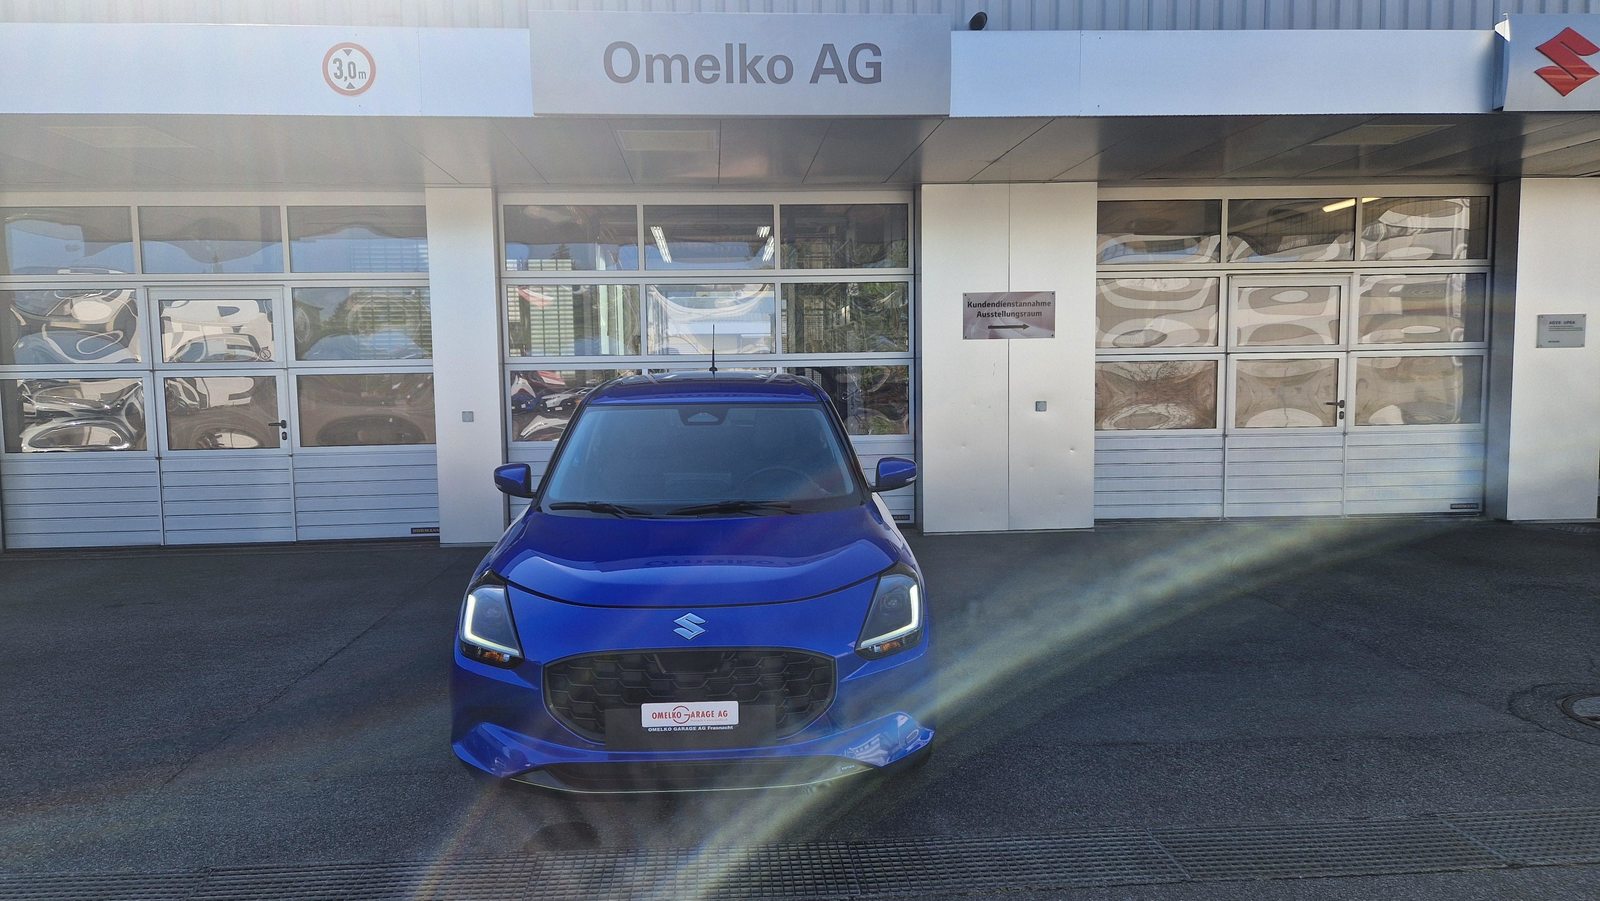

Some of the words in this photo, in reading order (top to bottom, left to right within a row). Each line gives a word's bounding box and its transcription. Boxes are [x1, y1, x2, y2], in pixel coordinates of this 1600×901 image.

[603, 41, 794, 84] Omelko
[809, 43, 882, 84] AG
[967, 300, 1052, 308] Kundendienstannahme
[976, 310, 1043, 318] Ausstellungsraum
[651, 711, 682, 719] OMELKO
[718, 710, 728, 718] AG
